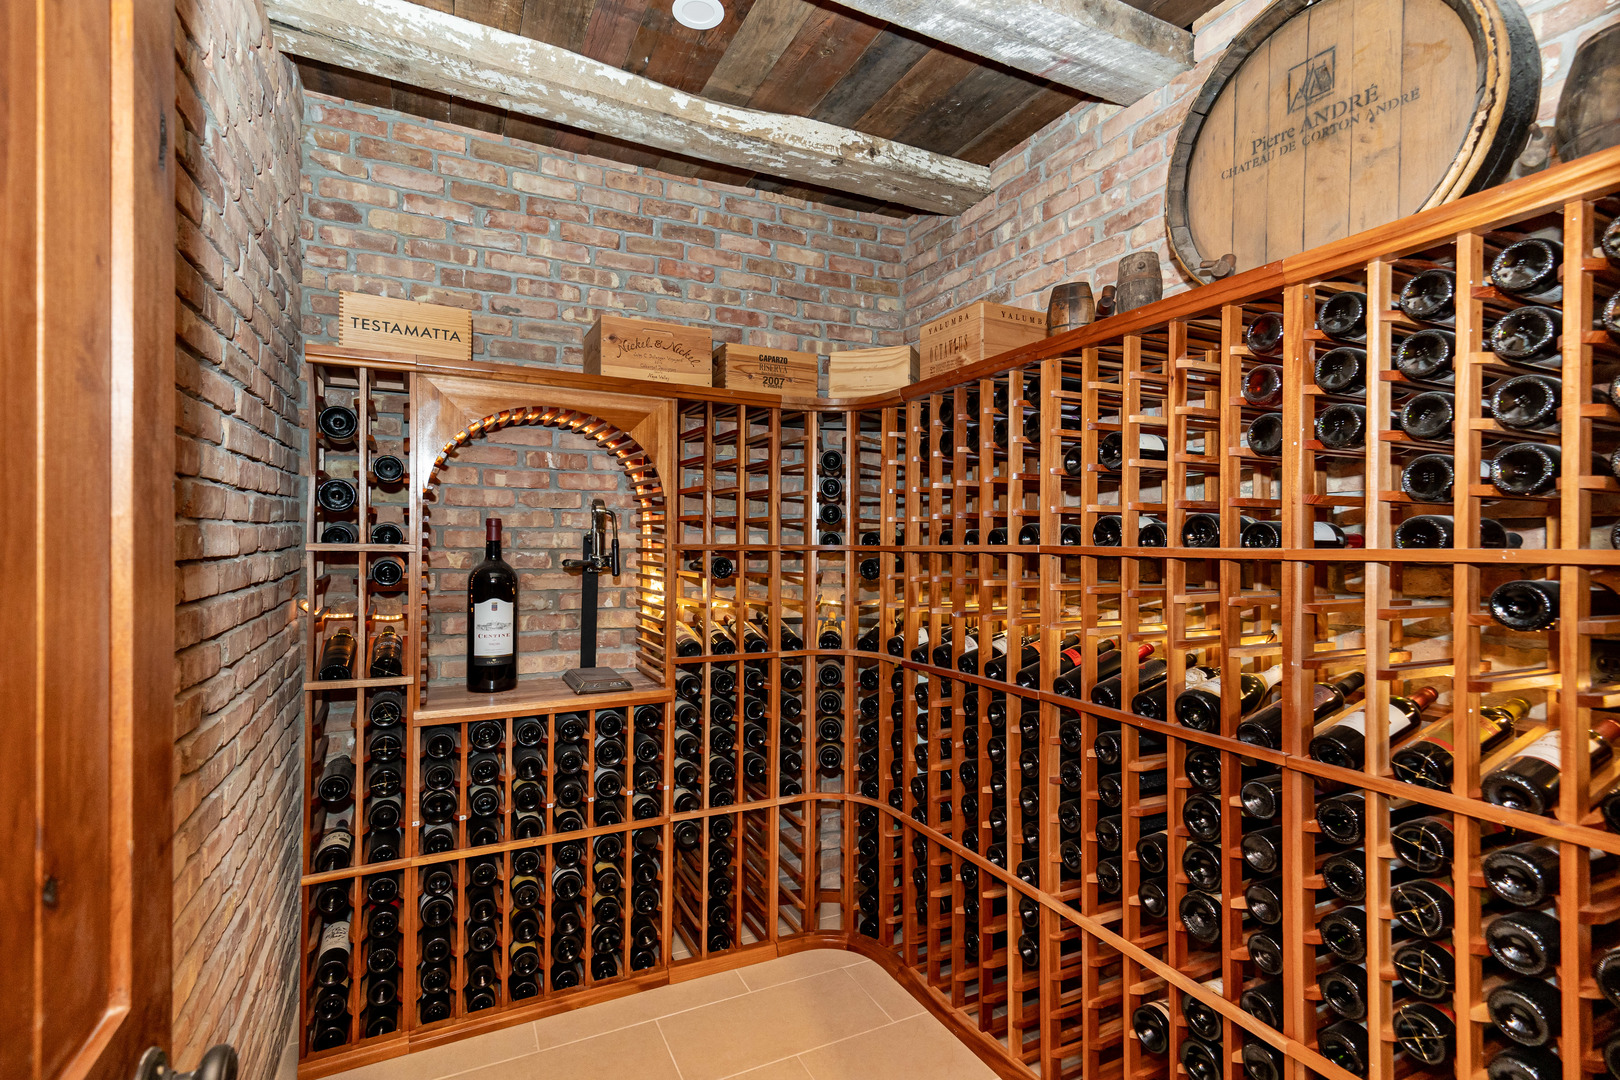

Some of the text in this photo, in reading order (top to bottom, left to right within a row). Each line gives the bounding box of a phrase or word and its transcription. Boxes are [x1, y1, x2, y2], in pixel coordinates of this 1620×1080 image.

[1251, 127, 1296, 155] Pierre
[1300, 83, 1379, 134] ANDRÉ
[1279, 141, 1297, 156] DE
[1301, 112, 1360, 147] CORTON
[350, 316, 461, 343] TESTAMATTA
[928, 313, 970, 335] YALUMBA
[616, 337, 653, 358] Nickel
[654, 339, 663, 349] &
[662, 341, 701, 368] Nickel
[758, 354, 788, 365] CAPARZO
[759, 362, 788, 374] RISERVA
[762, 376, 785, 386] 2007
